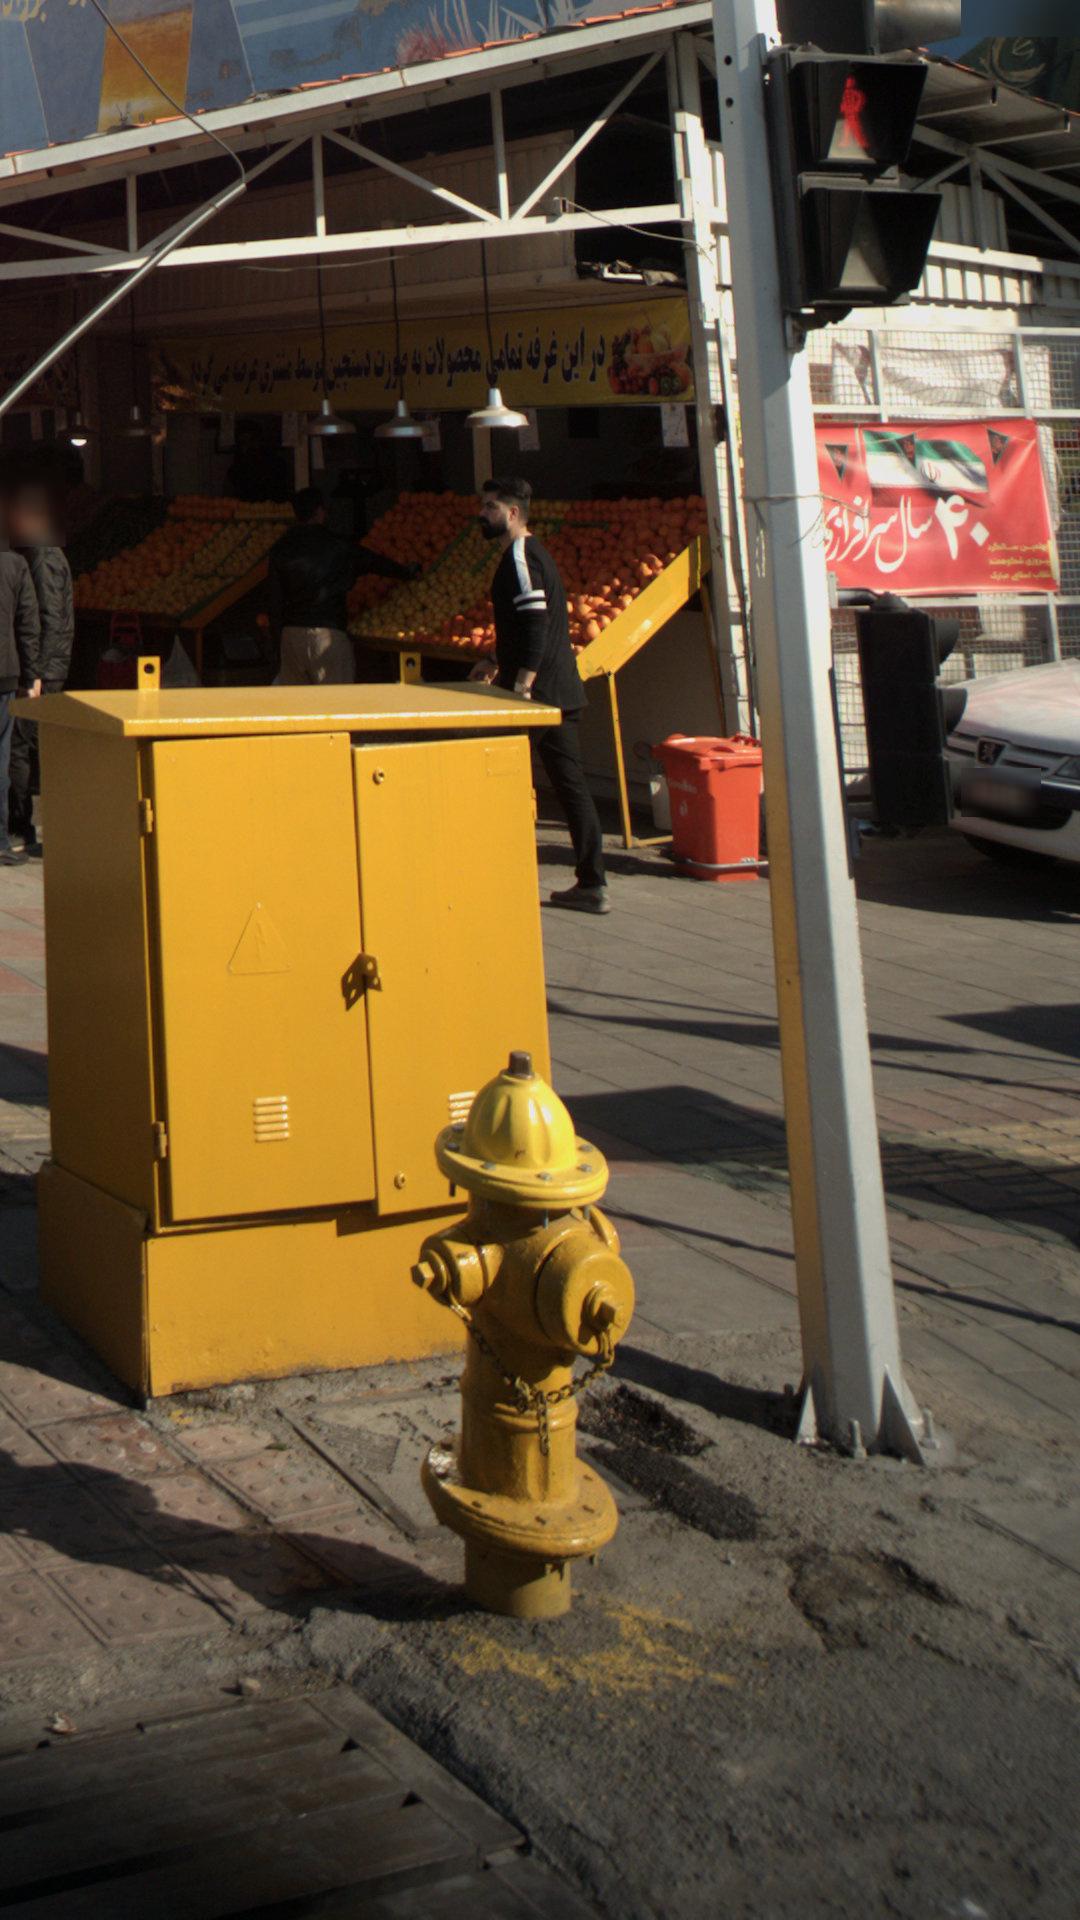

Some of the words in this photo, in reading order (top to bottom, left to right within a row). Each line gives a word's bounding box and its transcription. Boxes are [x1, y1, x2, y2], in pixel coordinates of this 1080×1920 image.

[562, 326, 585, 382] این
[590, 334, 605, 381] در
[874, 494, 933, 574] سال
[934, 494, 990, 561] ۴۰
